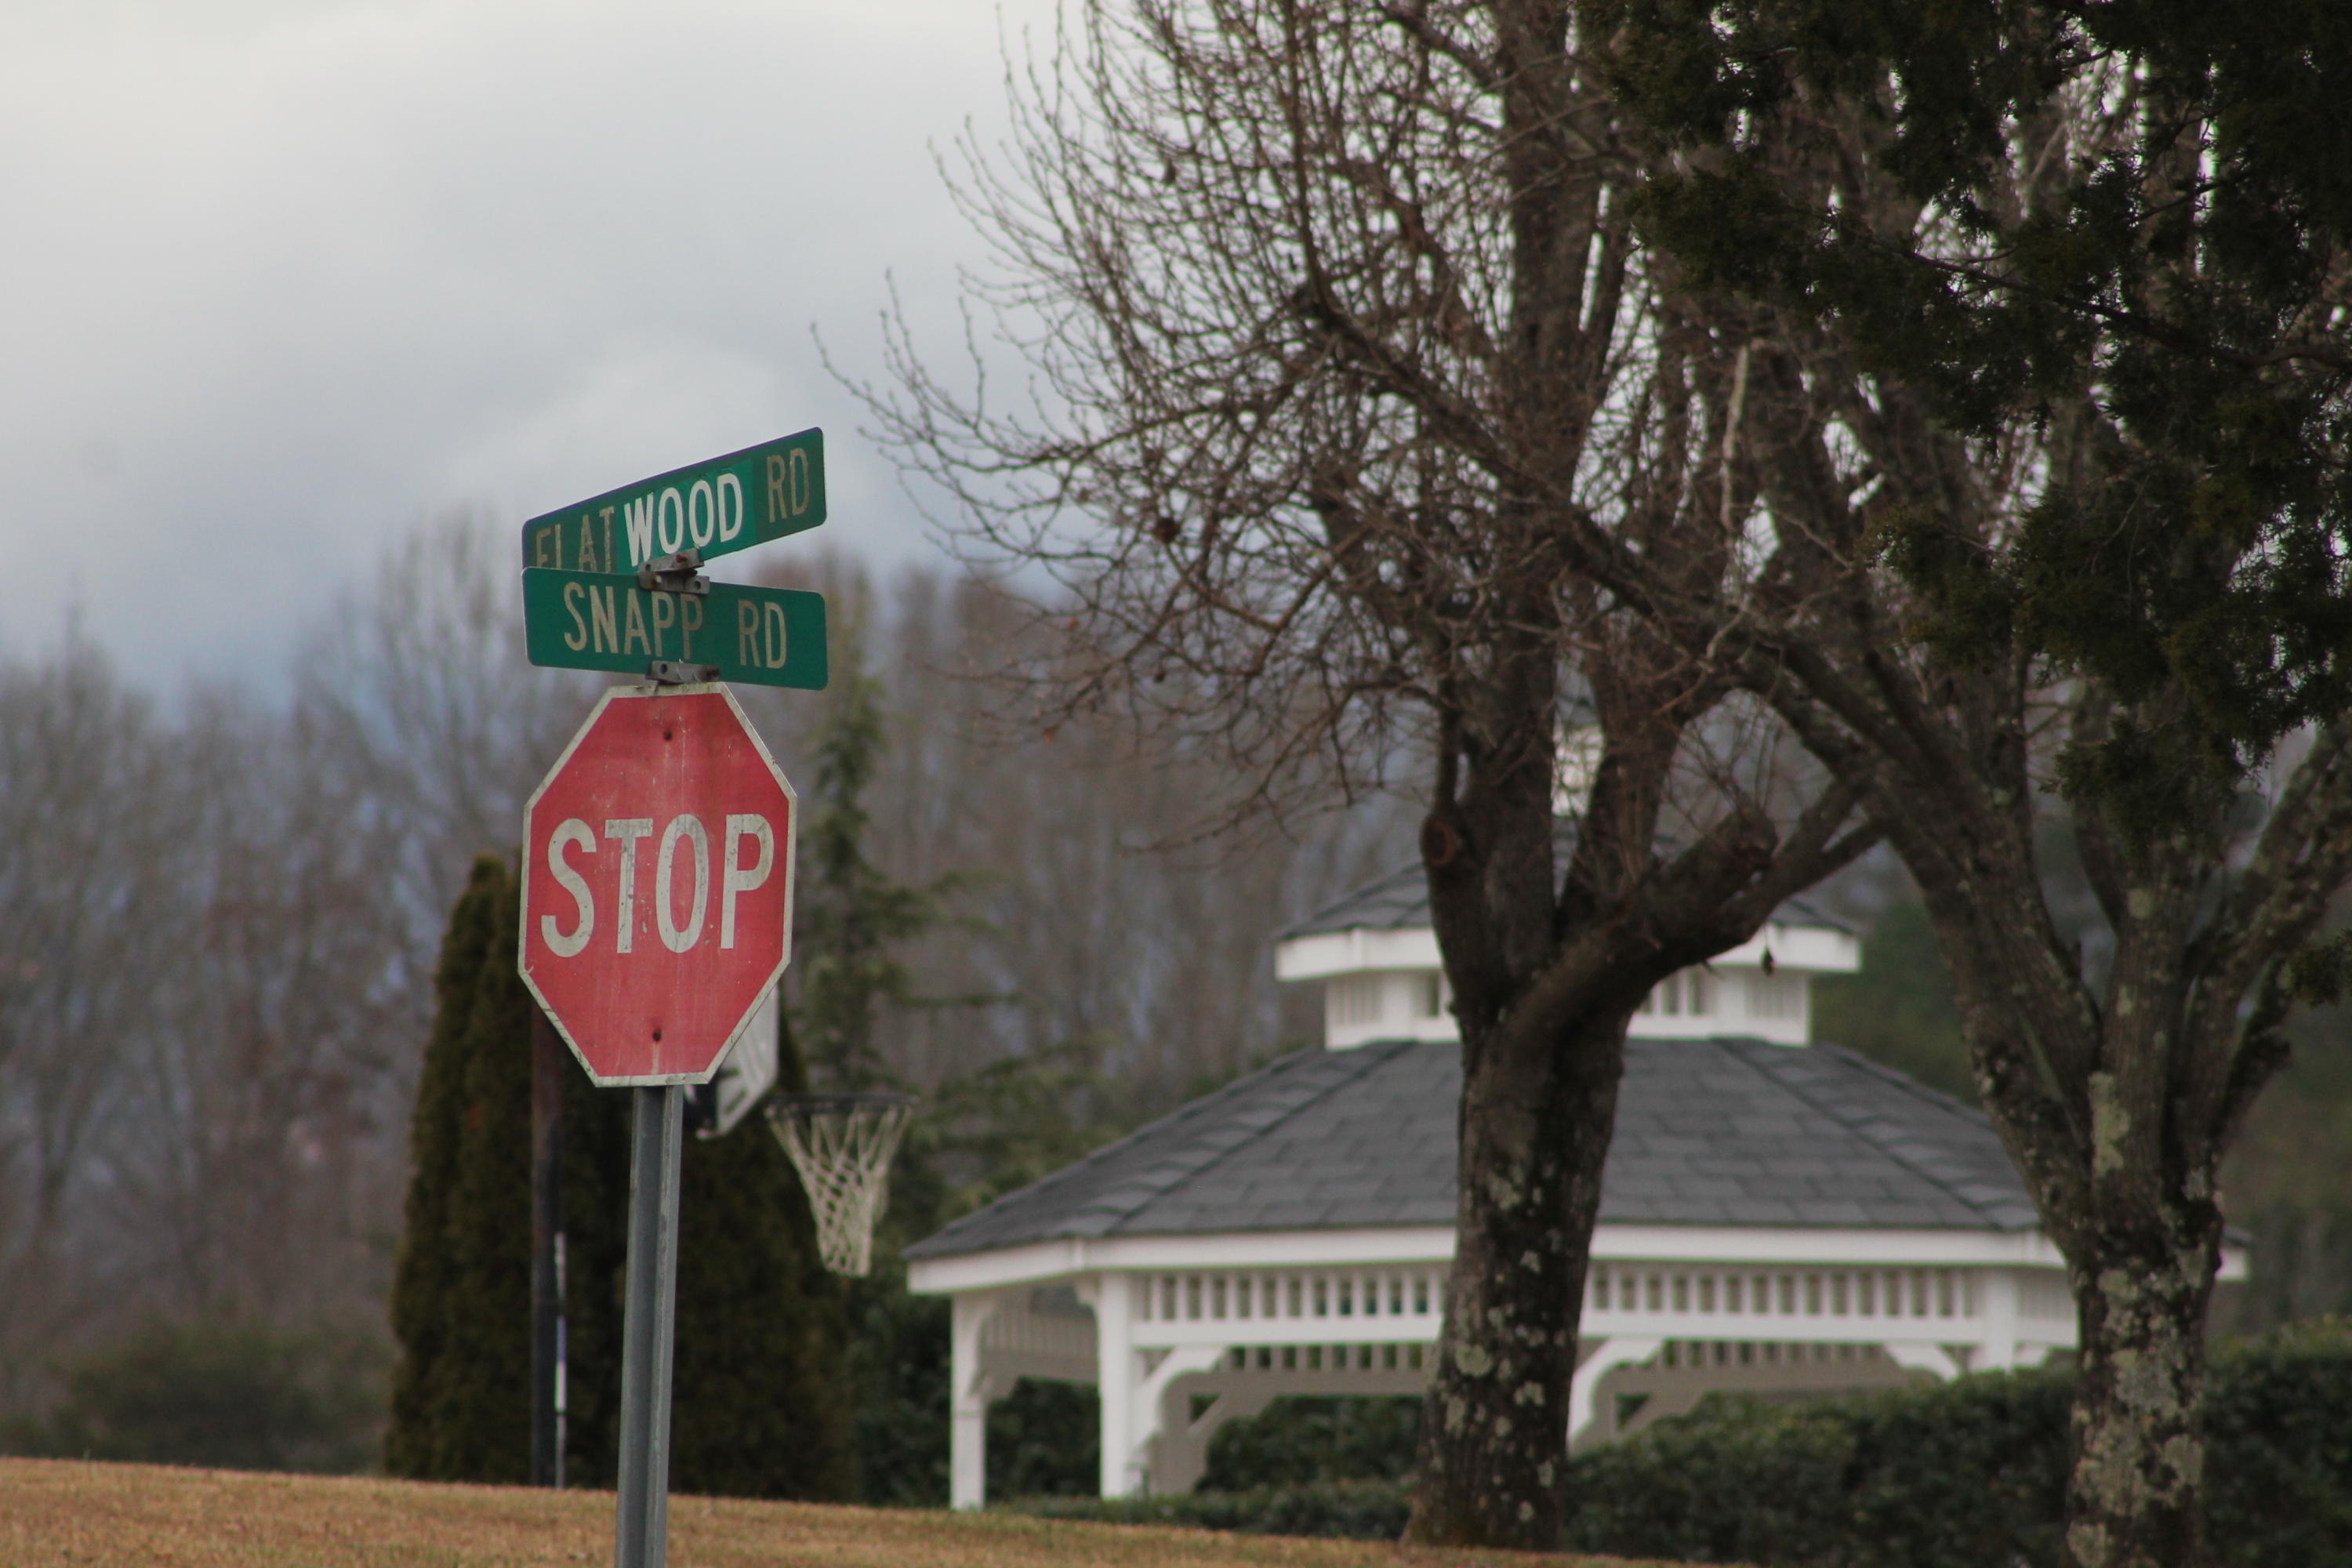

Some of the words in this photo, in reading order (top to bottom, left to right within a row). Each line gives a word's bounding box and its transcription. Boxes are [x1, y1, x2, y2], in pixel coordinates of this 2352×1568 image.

[766, 448, 810, 524] RD
[563, 582, 703, 660] SNAPP
[738, 599, 787, 670] RD
[540, 813, 775, 958] STOP
